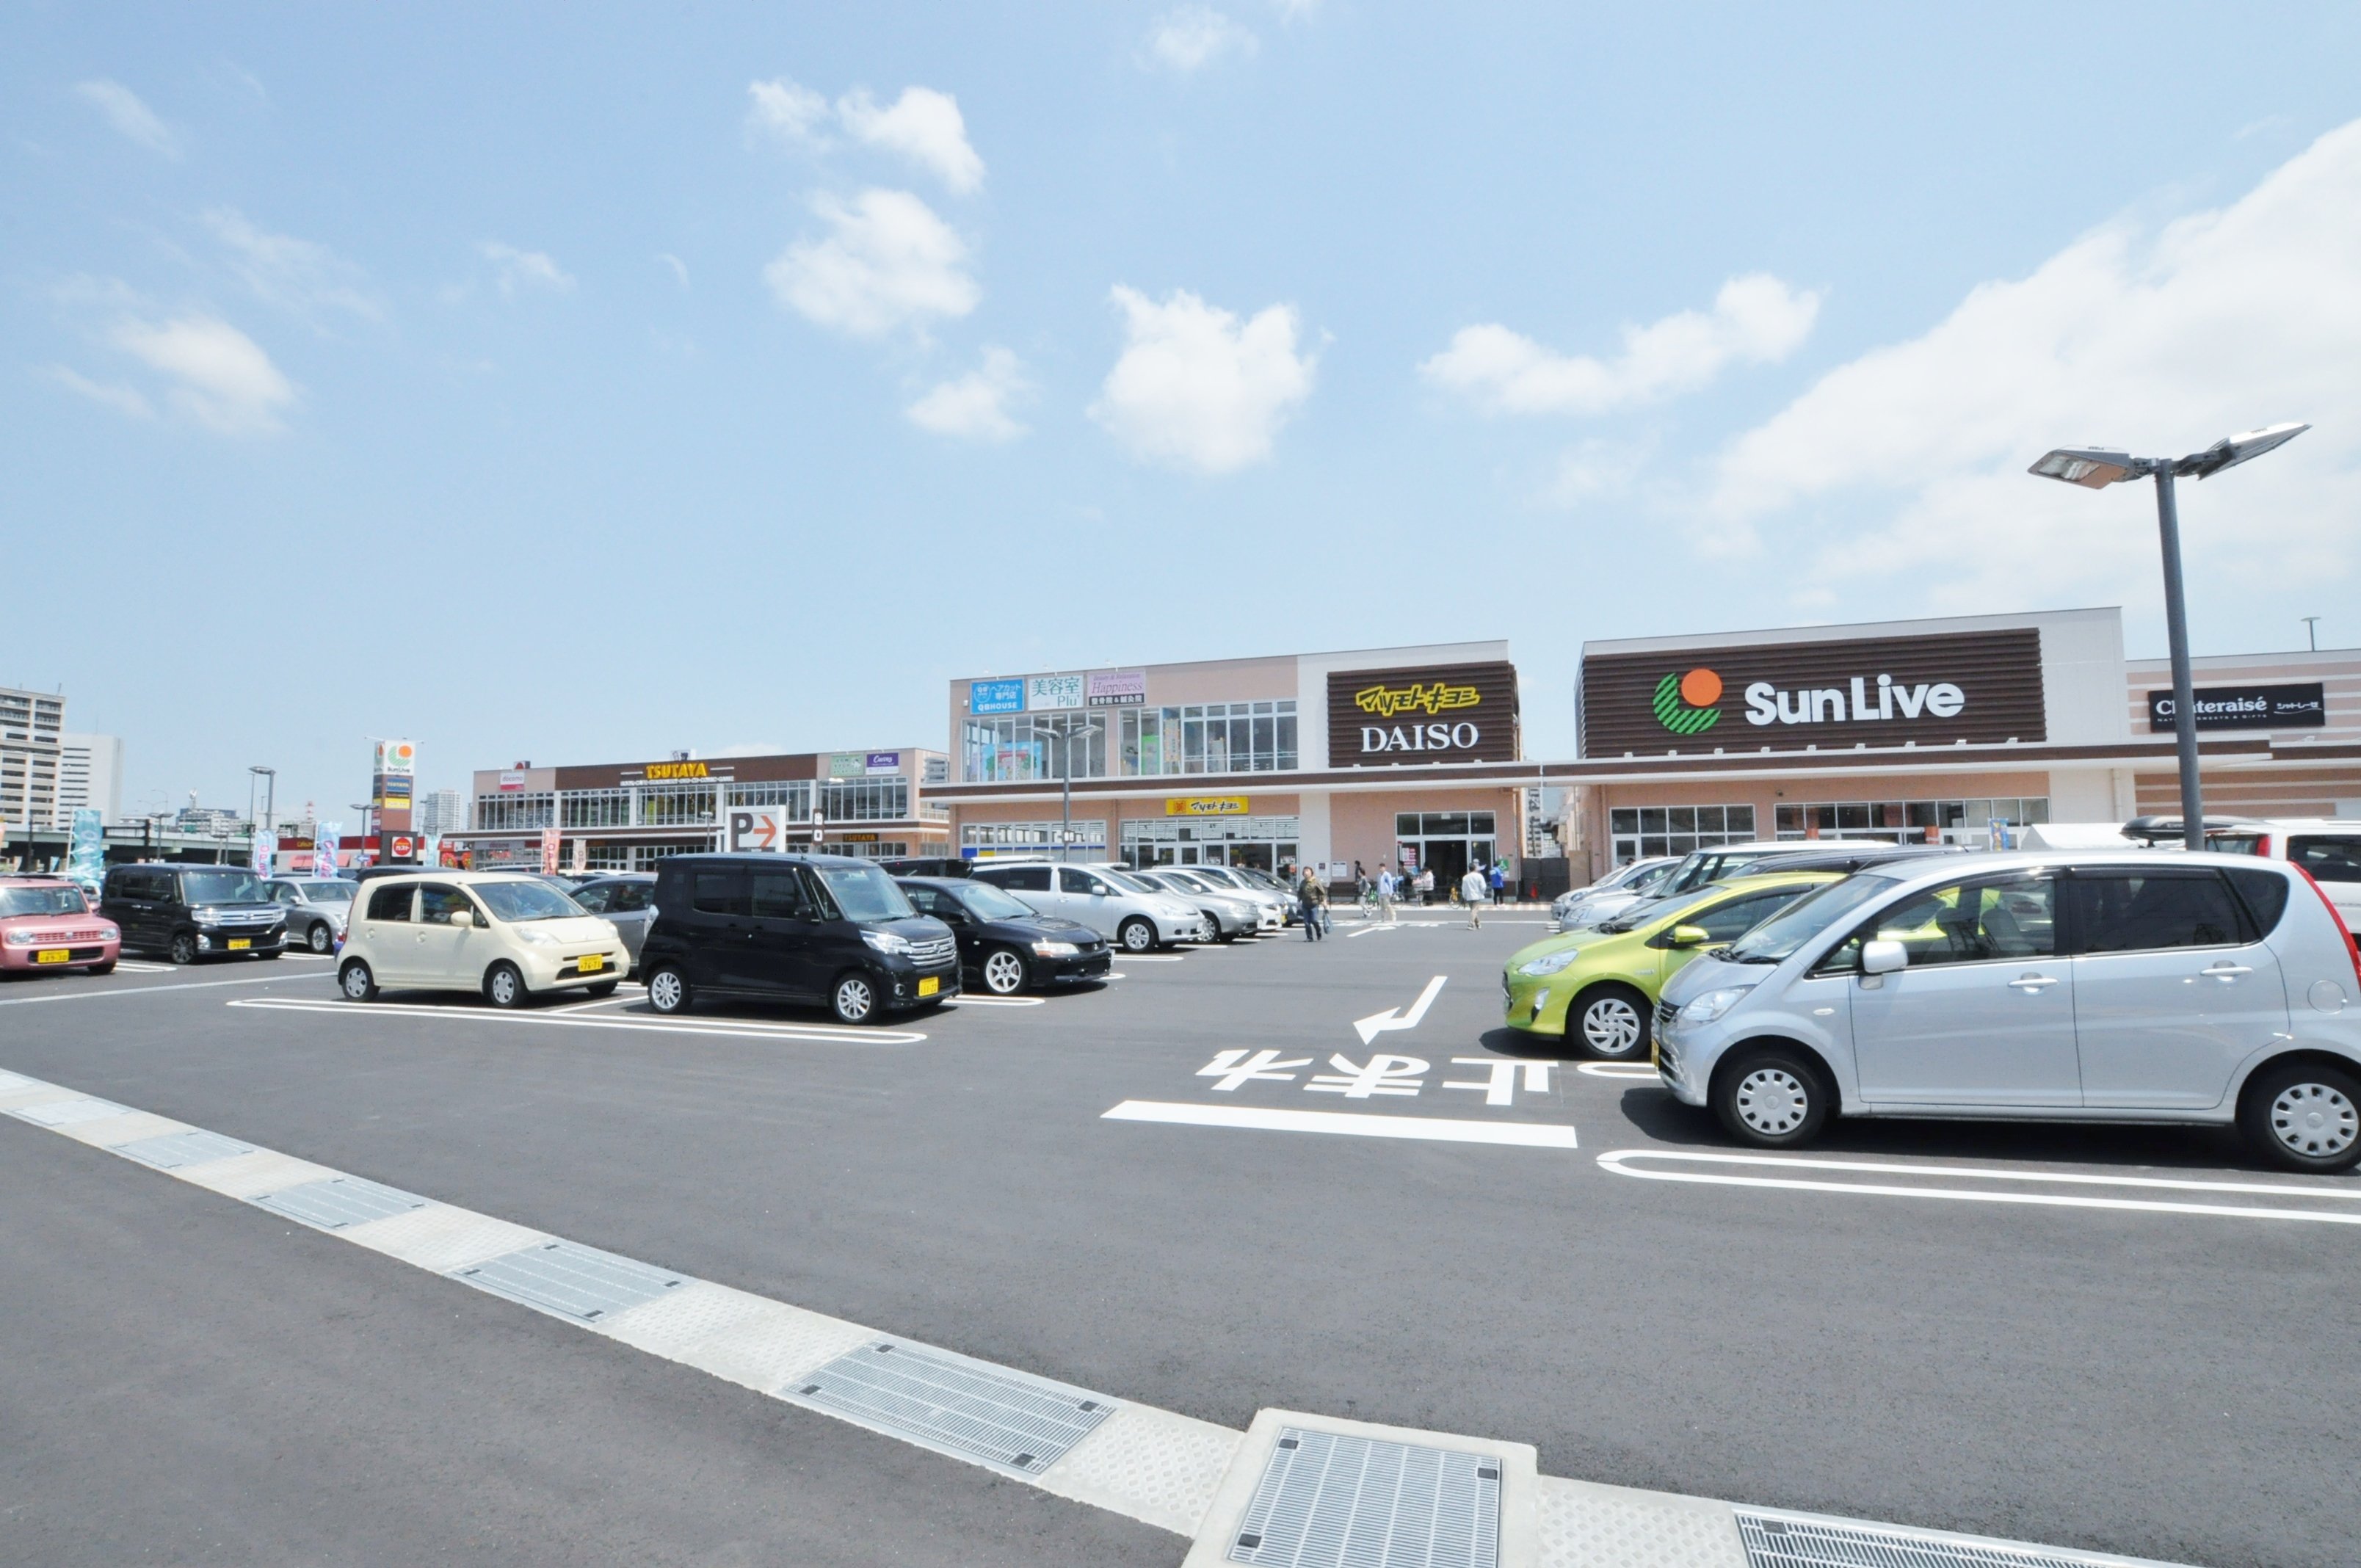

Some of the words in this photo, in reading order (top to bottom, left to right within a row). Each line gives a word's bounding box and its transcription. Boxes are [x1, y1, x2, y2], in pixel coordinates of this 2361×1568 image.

[1032, 676, 1081, 697] 美容室
[1092, 680, 1143, 694] Happiness
[1355, 683, 1481, 716] マツモトキヨシ
[2155, 696, 2268, 715] Cteraisé
[1360, 722, 1479, 752] DAISO
[645, 762, 707, 779] TSUTAYA
[730, 813, 754, 852] P
